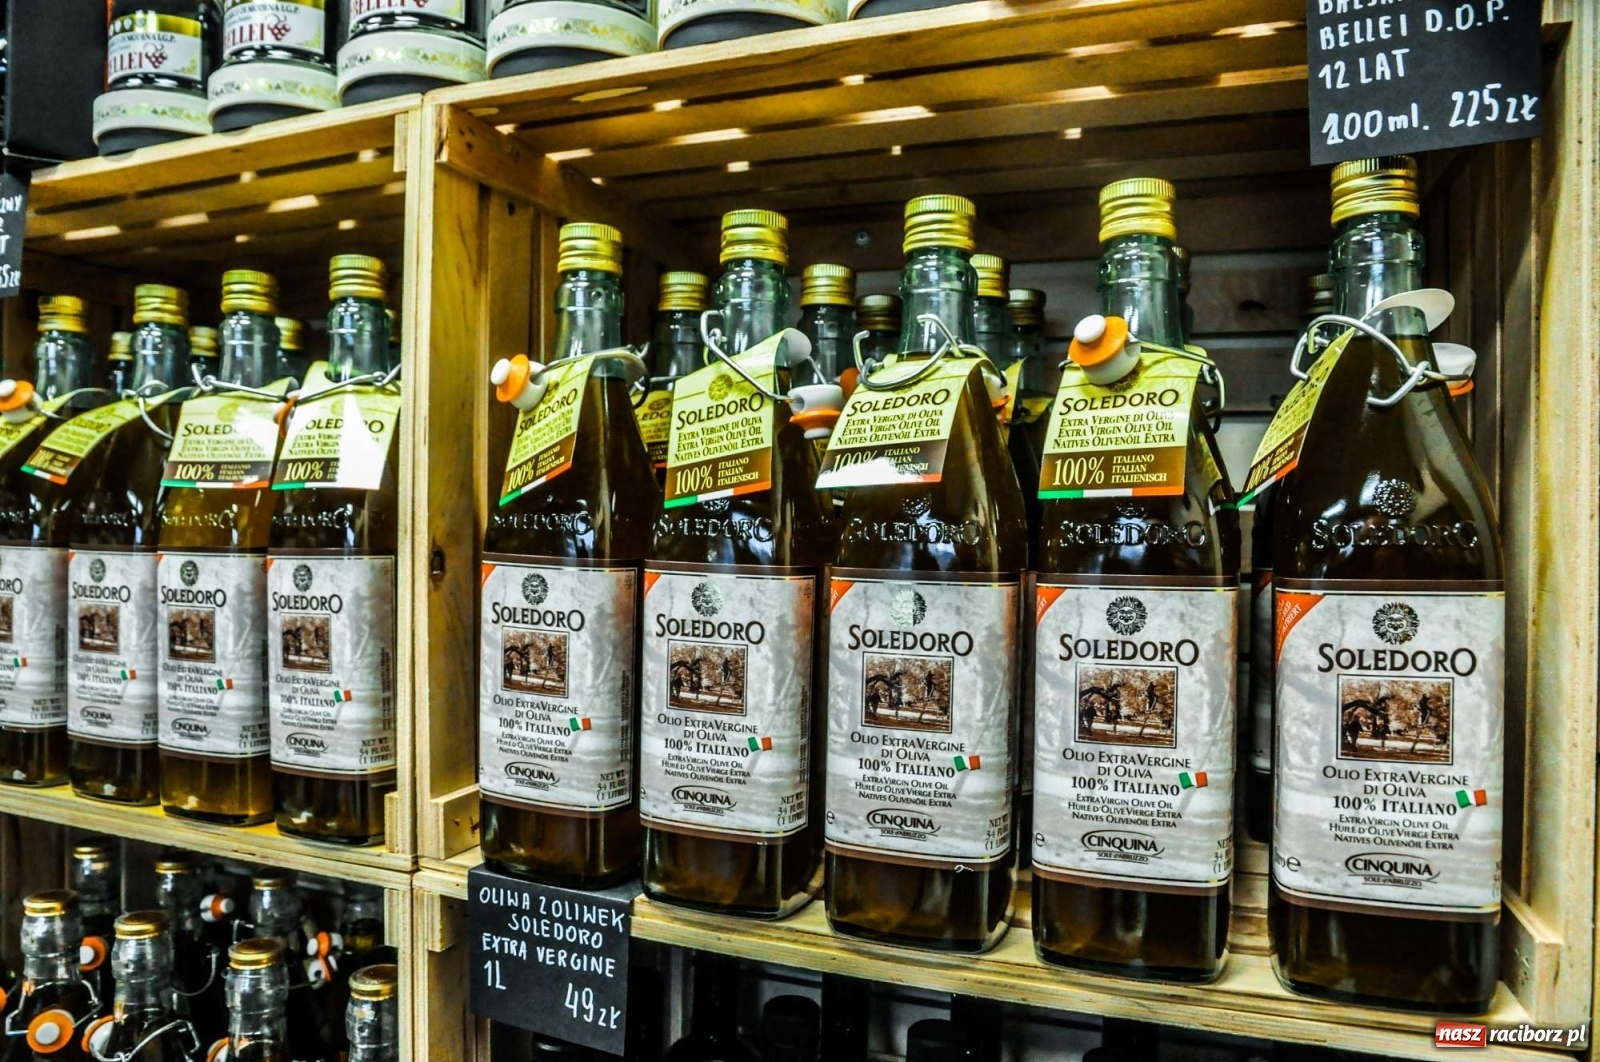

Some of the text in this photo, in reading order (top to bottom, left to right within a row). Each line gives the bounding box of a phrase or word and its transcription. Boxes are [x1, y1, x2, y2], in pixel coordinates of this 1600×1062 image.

[1319, 14, 1408, 50] BELLEI
[1318, 48, 1411, 89] 12 LAT
[676, 392, 765, 430] SOLEDORO
[846, 388, 951, 418] SOLEDORO
[1059, 388, 1180, 416] SOLEDORO
[517, 388, 578, 438] SOLEDORO
[845, 418, 870, 428] EXTRA
[873, 413, 905, 424] VERGINE
[918, 409, 943, 418] OLIVA
[1060, 413, 1144, 428] EXTRA VERGINE DI
[678, 416, 763, 443] EXTRA VERGINE DI OLIVA
[841, 417, 940, 437] EXTRA VIRGIN OLIVE OIL
[1057, 421, 1173, 438] EXTRA VIRGIN OLIVE OIL
[676, 425, 762, 452] EXTRA VIRGIN OLIVE OIL
[835, 435, 867, 446] NATIVES
[913, 428, 941, 438] EXTRA
[1052, 438, 1090, 450] NATIVES
[1144, 433, 1176, 444] EXTRA
[673, 450, 701, 464] NATIVES
[740, 436, 765, 450] EXTRA
[884, 446, 921, 456] ITALIANO
[1113, 454, 1155, 464] ITALIANO
[174, 463, 215, 480] 100%
[283, 461, 325, 481] 100%
[718, 456, 750, 470] ITALIANO
[718, 466, 744, 478] ITALIAN
[1052, 456, 1105, 486] 100%
[1112, 463, 1147, 474] ITALIAN
[507, 458, 536, 493] 100%
[674, 464, 713, 495] 100%
[717, 471, 759, 487] ITALIENISCH
[1111, 472, 1168, 484] ITALIENISCH
[72, 581, 131, 603] SOLEDORO
[161, 585, 227, 608] SOLEDORO
[272, 591, 343, 614] SOLEDORO
[491, 601, 585, 632] SOLEDORO
[655, 613, 765, 645] SOLEDORO
[848, 623, 974, 657] SOLEDORO
[1059, 633, 1200, 667] SOLEDORO
[1317, 642, 1477, 677] SOLEDORO
[300, 696, 336, 708] ITALIANO
[493, 694, 514, 707] OLIO
[515, 710, 552, 722] DI OLIVA
[657, 713, 682, 727] OLIO
[499, 717, 571, 737] 100% ITALIANO
[683, 729, 728, 742] DI OLIVA
[850, 731, 879, 745] OLIO
[663, 738, 749, 758] 100% ITALIANO
[881, 748, 931, 762] DI OLIVA
[1062, 747, 1095, 763] OLIO
[508, 764, 556, 781] CINQUINA
[857, 757, 955, 778] 100% ITALIANO
[1097, 765, 1153, 779] DI OLIVA
[1322, 765, 1360, 781] OLIO
[1071, 775, 1181, 796] 100% ITALIANO
[1363, 783, 1427, 798] DI OLIVA
[676, 789, 732, 806] CINQUINA
[1131, 798, 1156, 808] OLIVE
[1158, 800, 1173, 809] OIL
[1332, 795, 1457, 816] 100% ITALIANO
[1067, 802, 1091, 812] HUILE
[1156, 810, 1182, 819] EXTRA
[871, 812, 935, 830] CINQUINA
[1072, 812, 1104, 823] NATIVES
[1151, 819, 1177, 828] EXTRA
[1402, 819, 1430, 830] OLIVE
[1432, 821, 1450, 830] OIL
[1329, 822, 1357, 834] HUILE
[1431, 830, 1460, 841] EXTRA
[1087, 834, 1158, 852] CINQUINA
[1334, 833, 1371, 845] NATIVES
[1425, 840, 1454, 850] EXTRA
[1351, 858, 1433, 876] CINQUINA
[479, 886, 530, 911] OLIWA
[508, 913, 603, 949] SOLEDORO
[482, 932, 616, 978] EXTRA VERGINE
[483, 960, 507, 991] 1L
